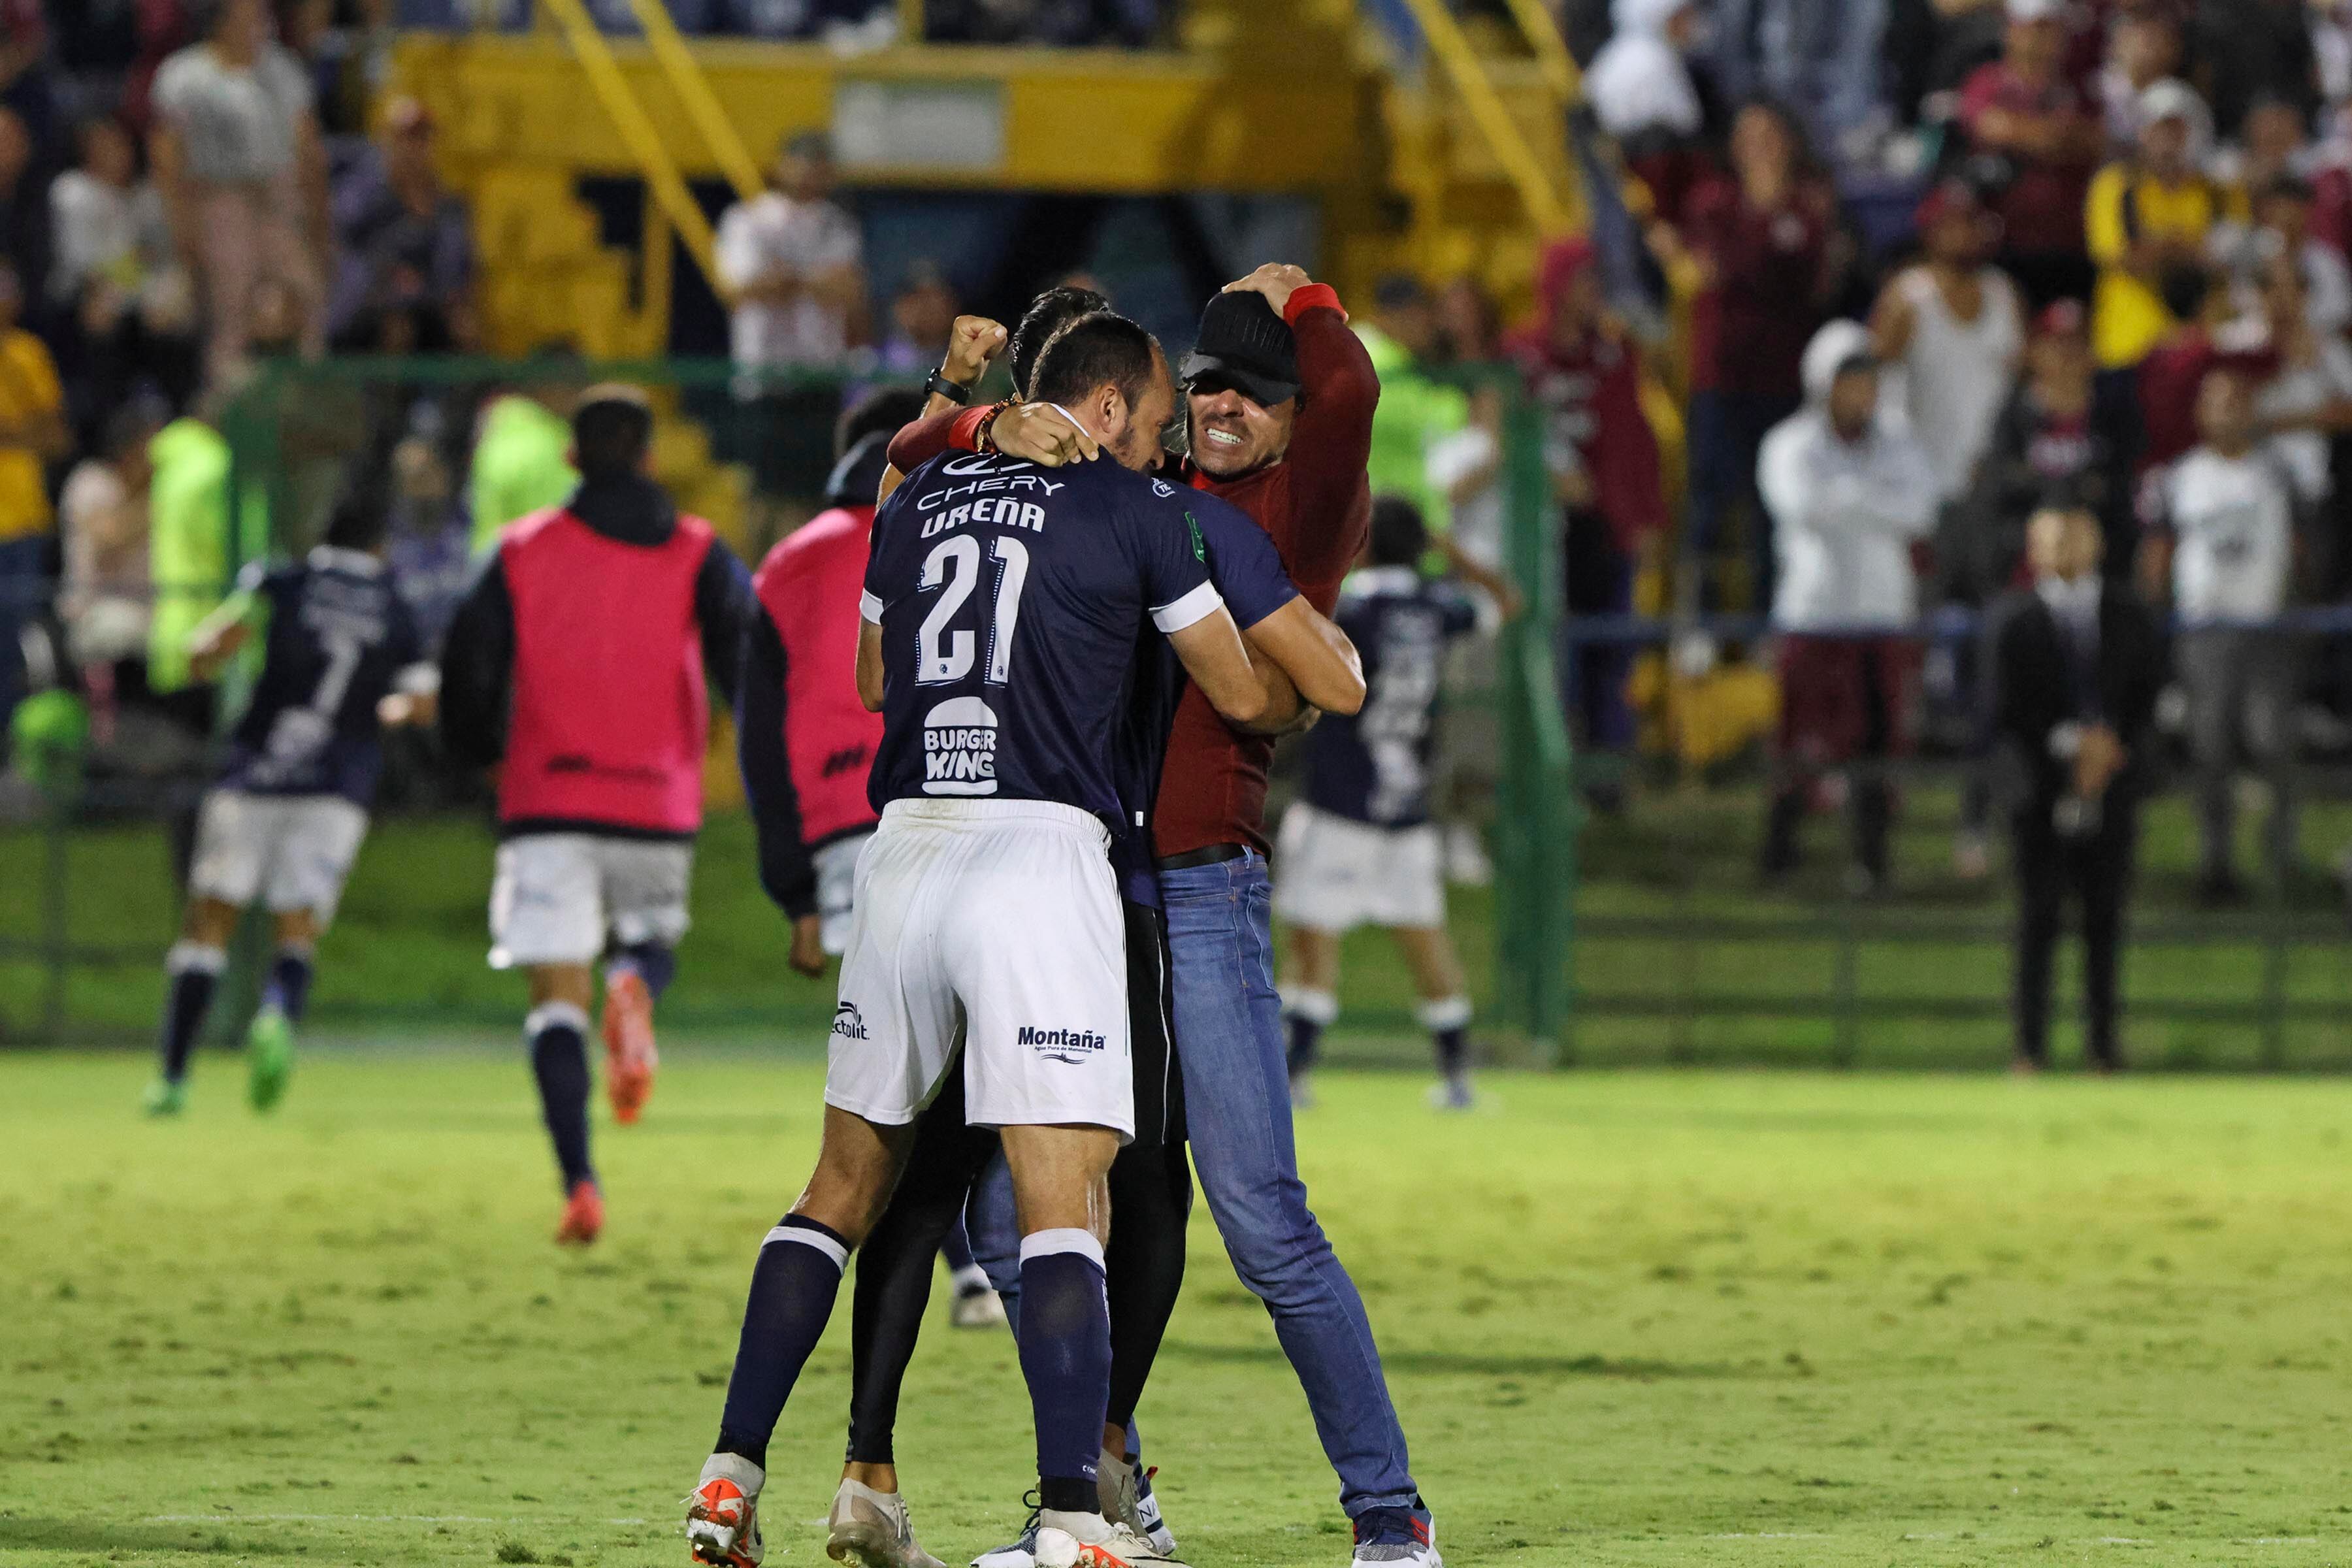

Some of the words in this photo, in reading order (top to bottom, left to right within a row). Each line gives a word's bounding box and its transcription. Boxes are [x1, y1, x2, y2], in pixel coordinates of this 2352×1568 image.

[917, 476, 1066, 511] CHERY
[921, 497, 1046, 538] UREÑA
[915, 534, 1030, 689] 21
[926, 750, 996, 781] KING
[1017, 1026, 1105, 1050] Montaña
